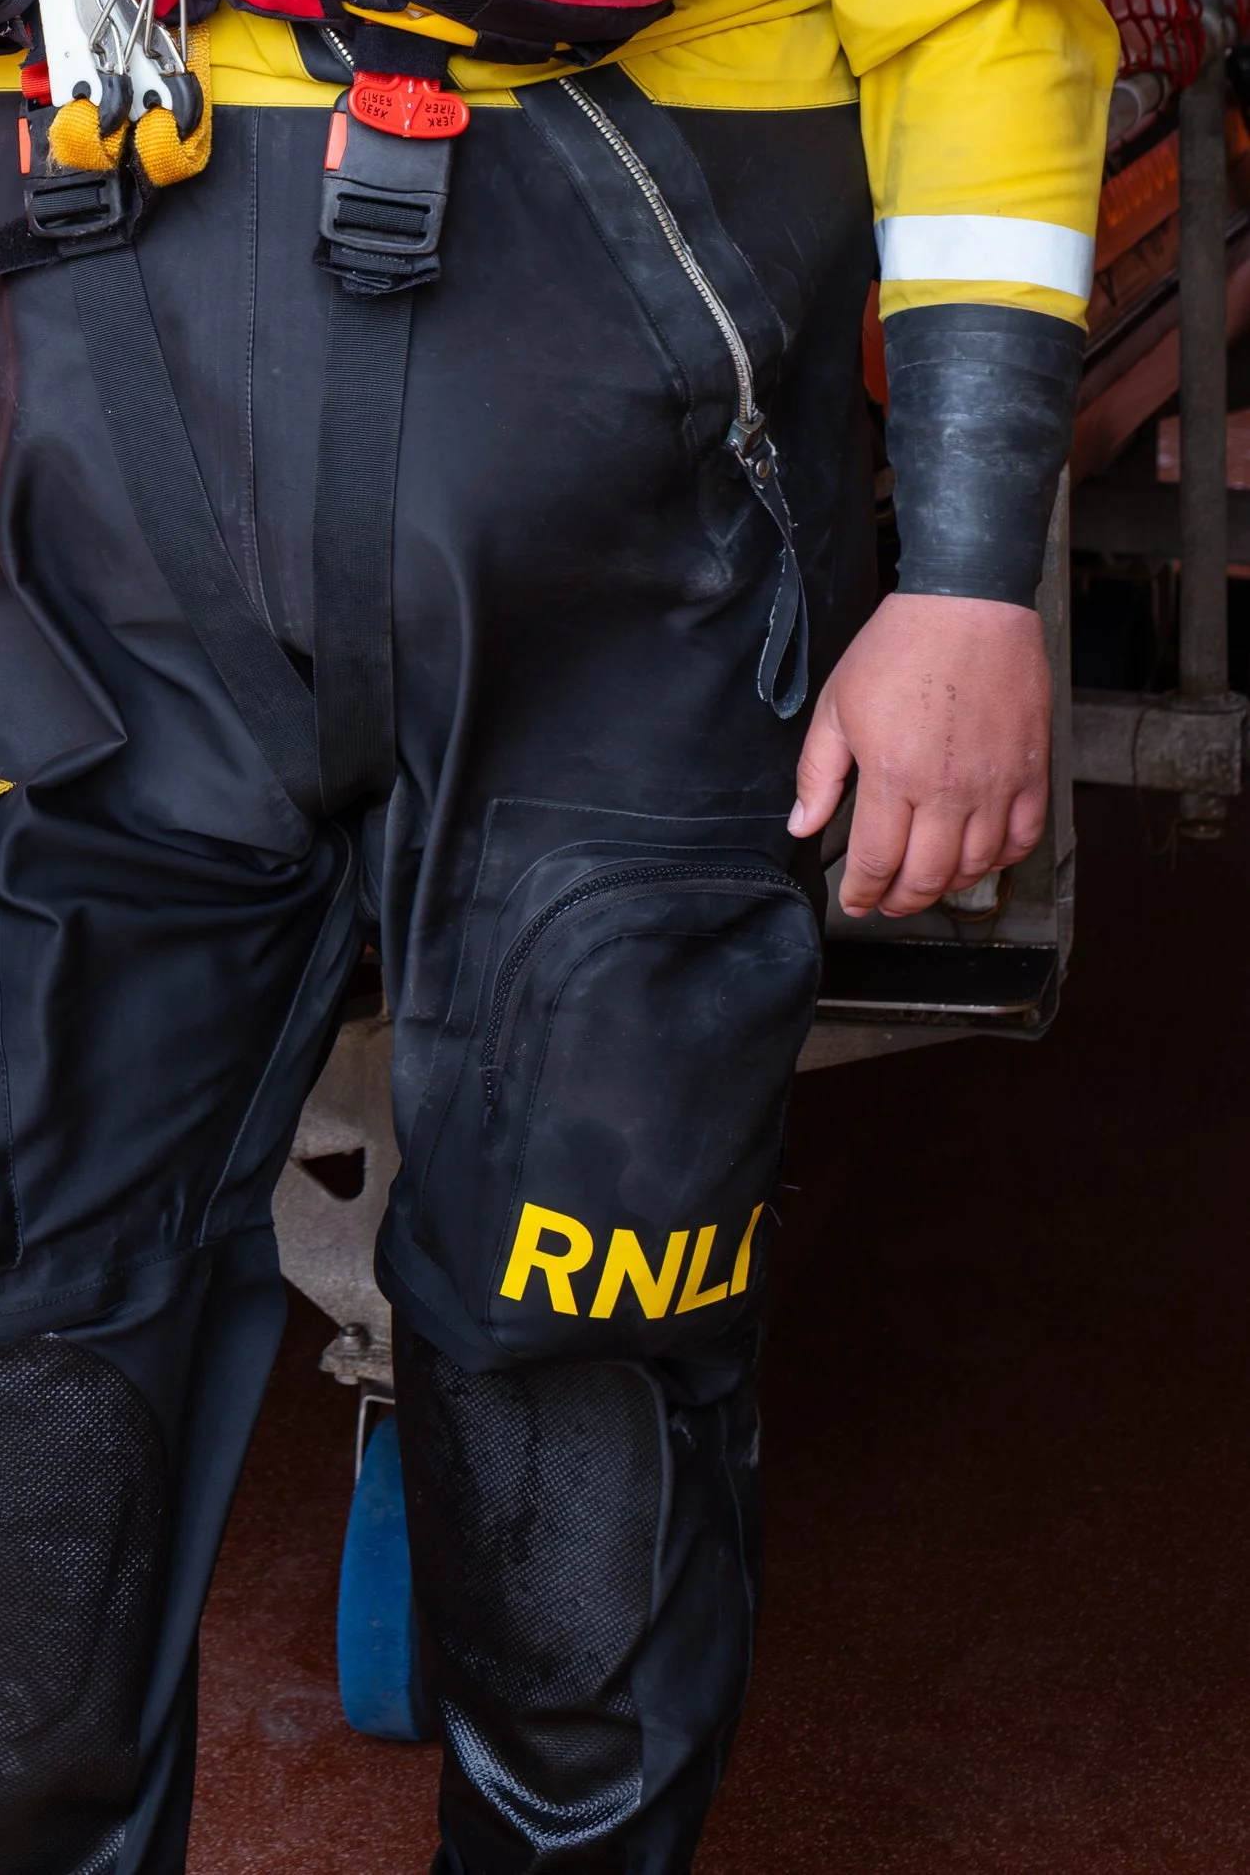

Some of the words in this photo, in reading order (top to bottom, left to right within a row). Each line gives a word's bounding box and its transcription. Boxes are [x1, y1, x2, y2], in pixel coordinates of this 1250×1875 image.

[425, 103, 456, 115] TIRER
[427, 115, 455, 127] JERK
[498, 1202, 765, 1320] RNLI
